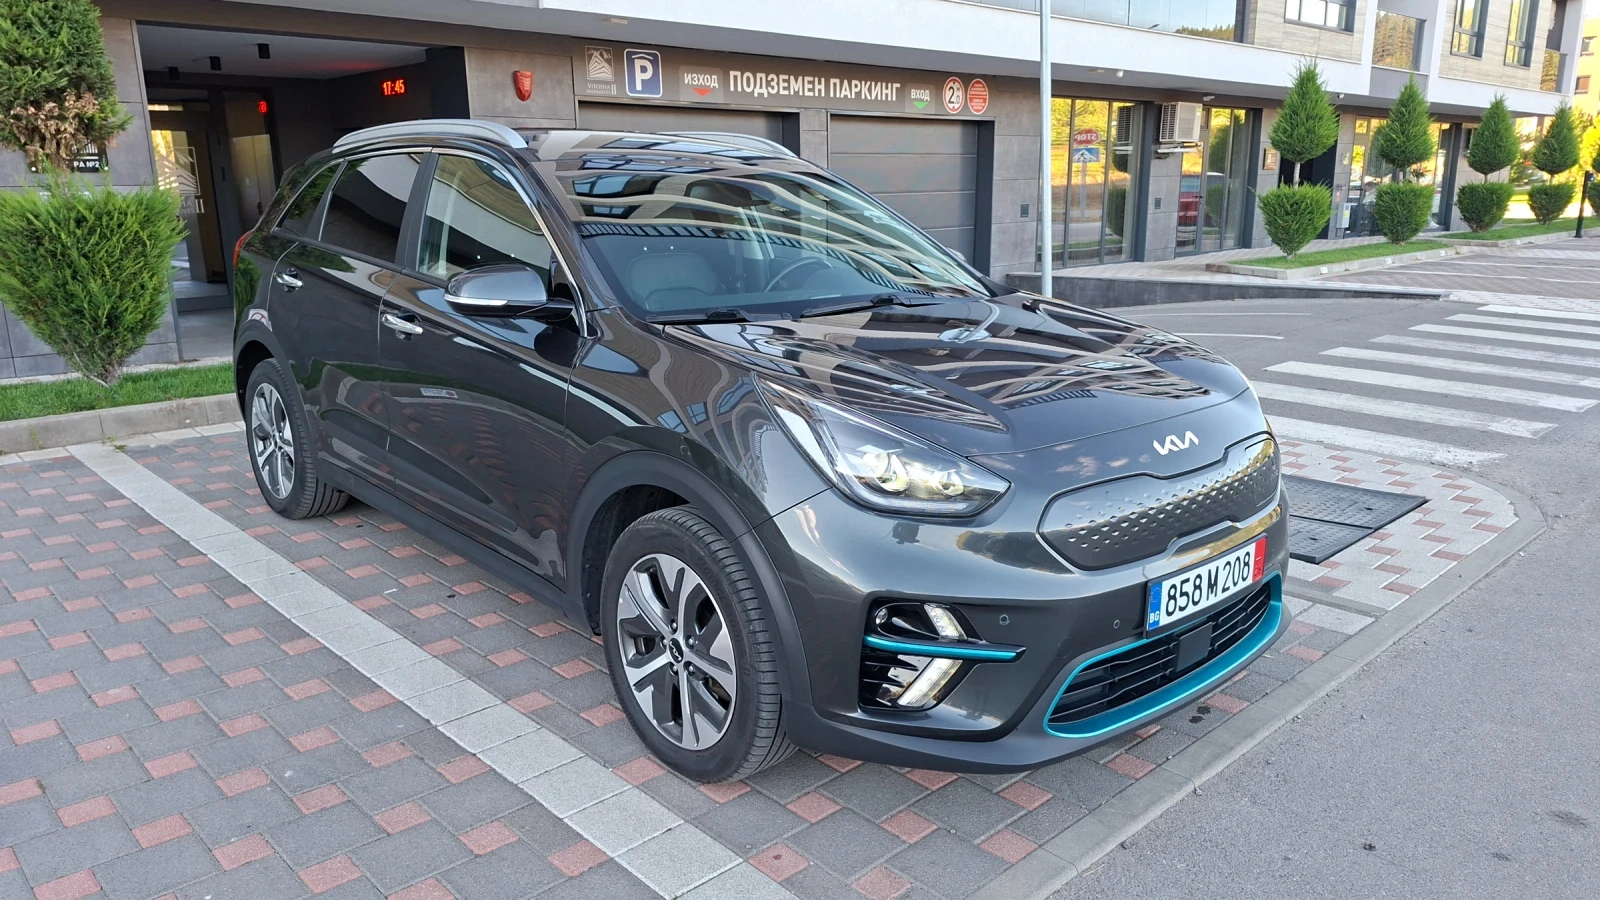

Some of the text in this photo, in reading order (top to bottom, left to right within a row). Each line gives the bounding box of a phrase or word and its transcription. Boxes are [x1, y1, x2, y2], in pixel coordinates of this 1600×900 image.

[634, 59, 653, 91] P
[684, 73, 719, 89] ИЗХОД
[383, 79, 405, 96] 17:45
[729, 70, 901, 101] ПОДЗЕМЕН ПАРКИНГ
[910, 88, 930, 101] ВХОД
[1166, 551, 1251, 617] 858 M 208
[1149, 611, 1160, 624] BG
